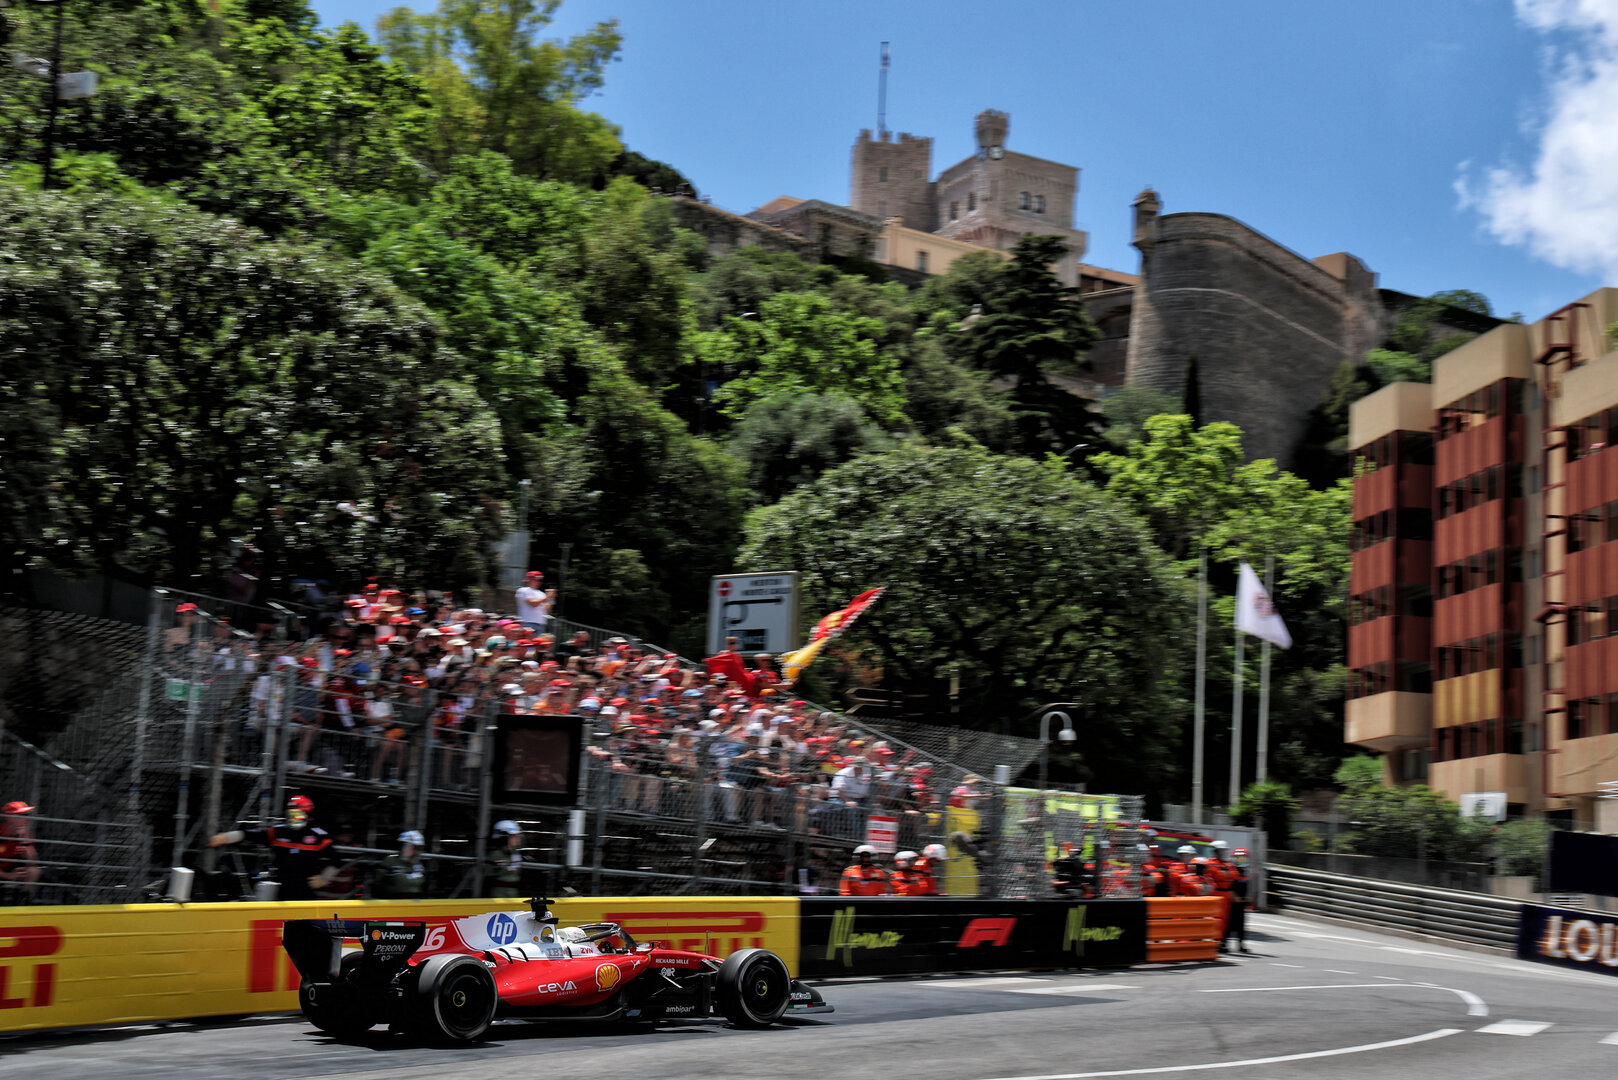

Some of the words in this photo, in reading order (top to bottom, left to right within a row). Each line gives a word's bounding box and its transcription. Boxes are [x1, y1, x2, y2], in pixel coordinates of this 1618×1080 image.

[381, 931, 415, 940] V-Power
[491, 913, 514, 945] hp
[956, 918, 1018, 947] F1
[374, 944, 406, 952] PERONI
